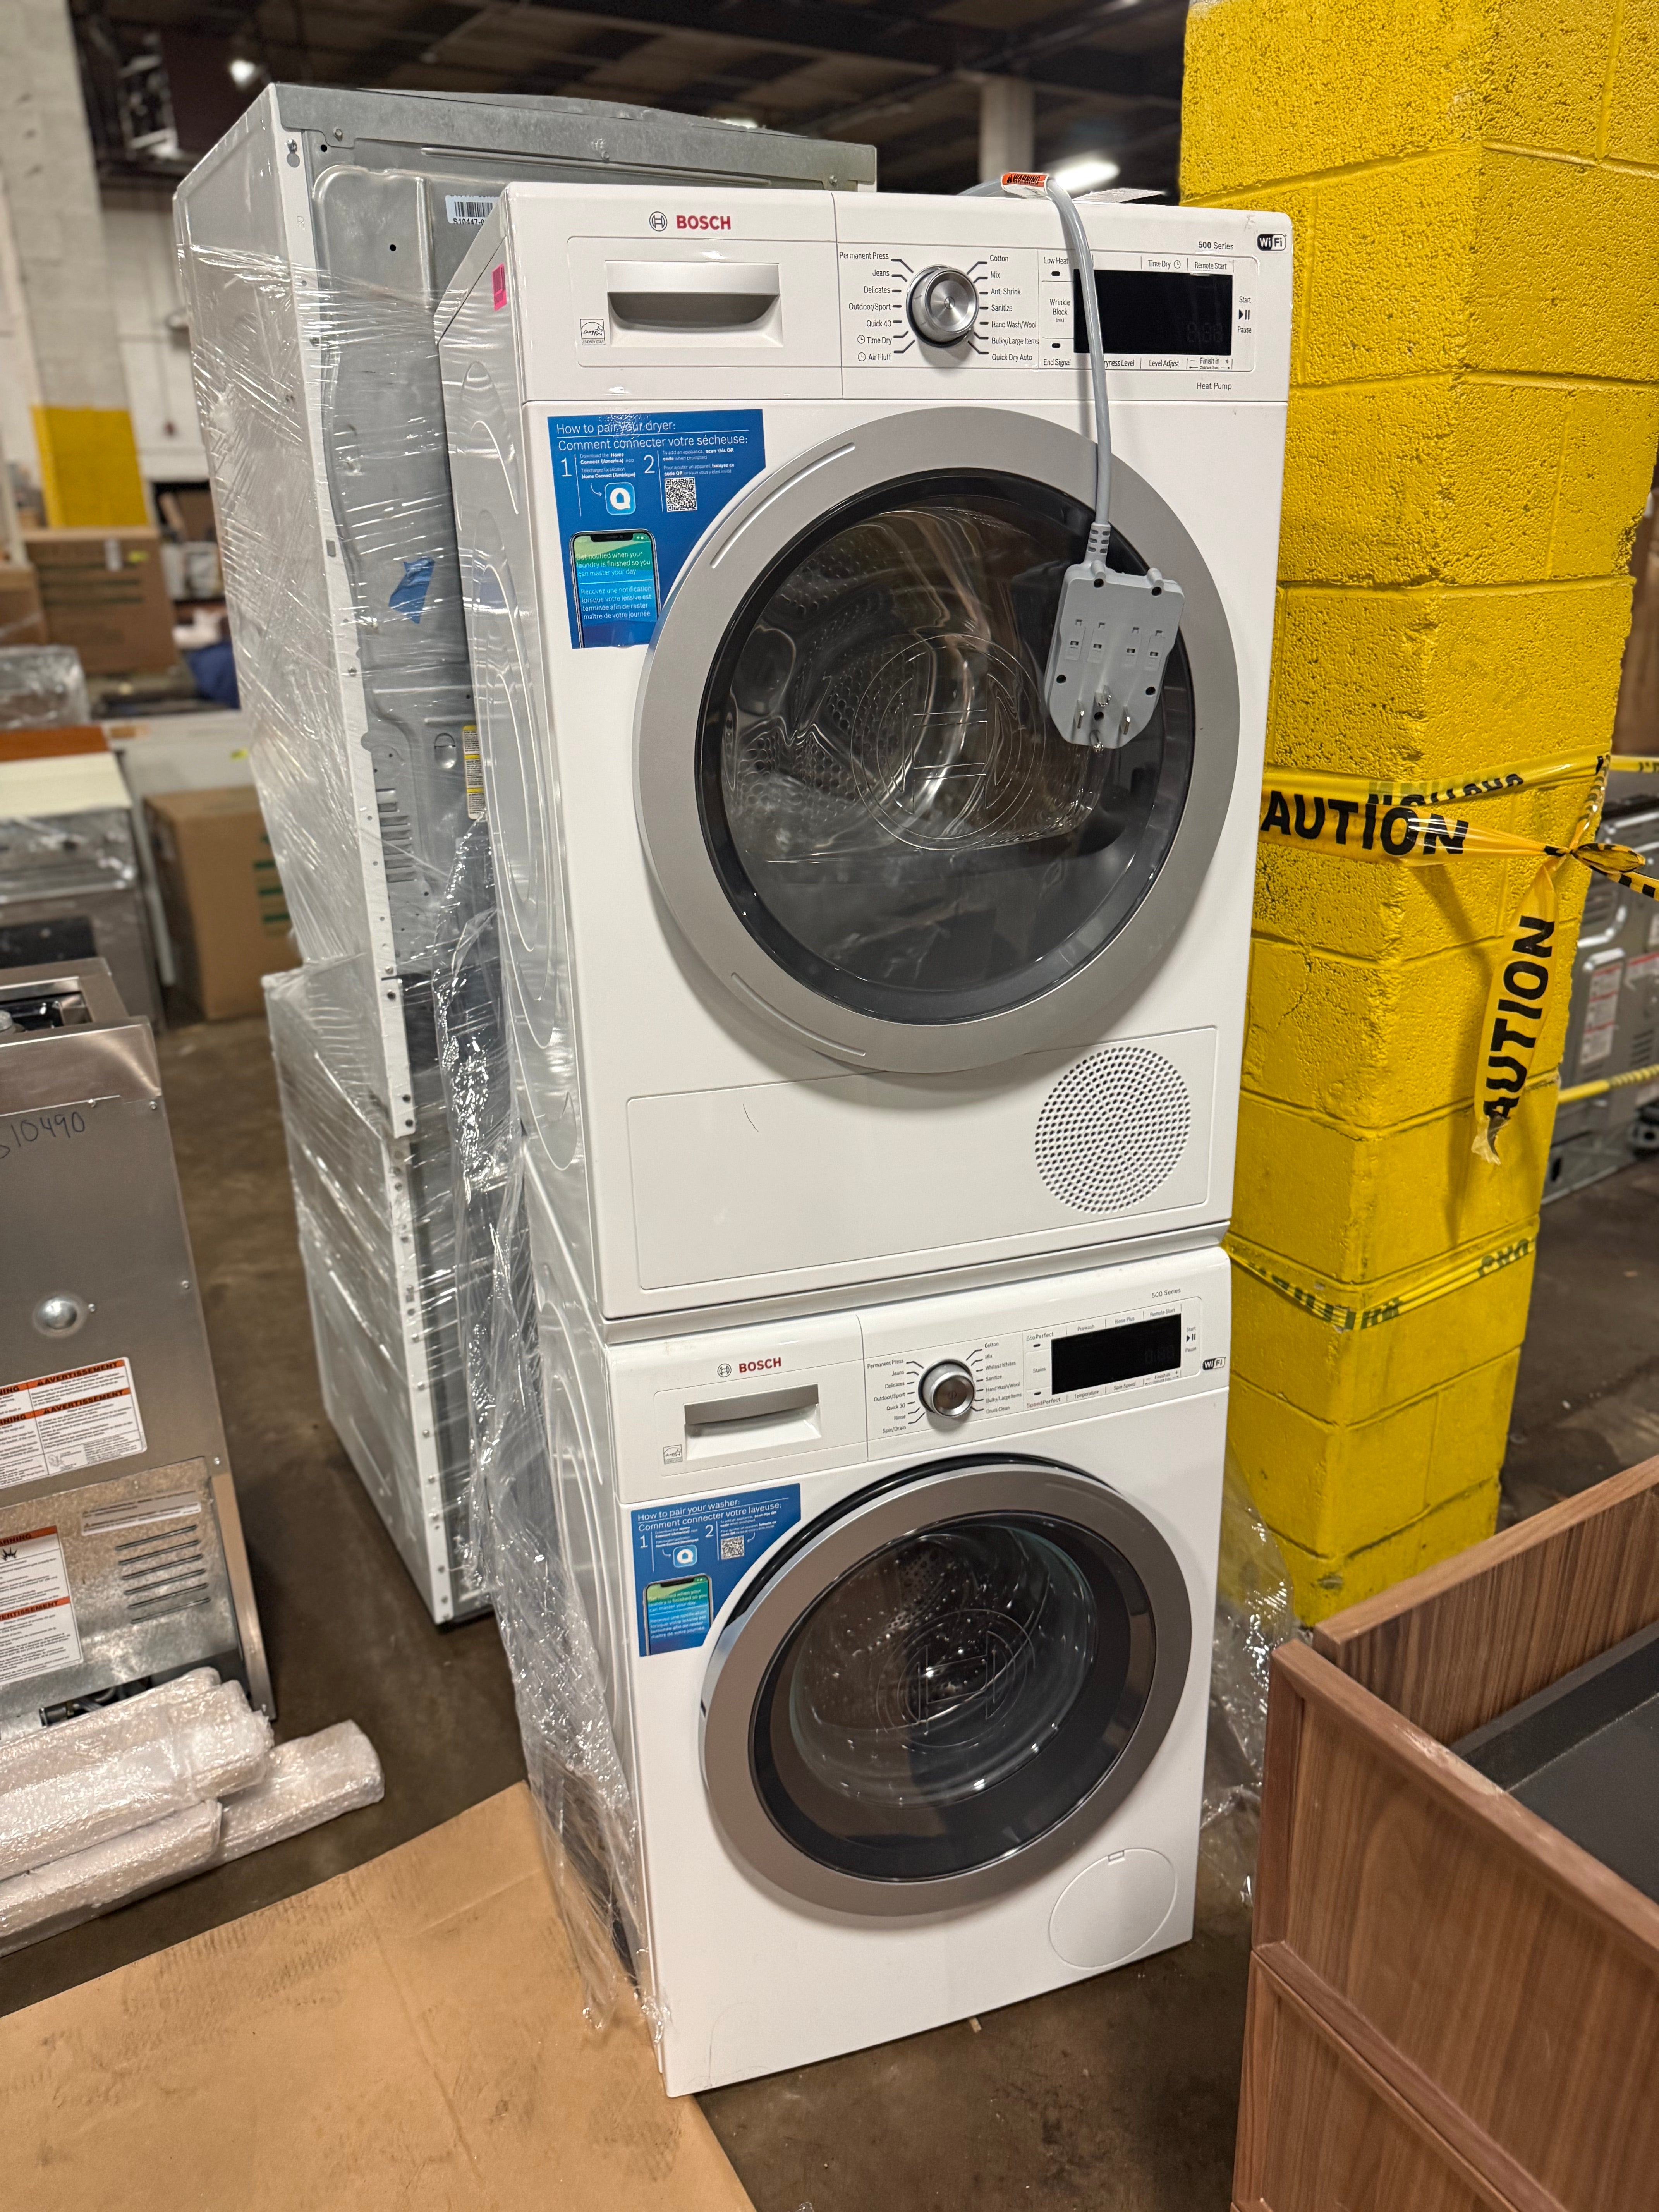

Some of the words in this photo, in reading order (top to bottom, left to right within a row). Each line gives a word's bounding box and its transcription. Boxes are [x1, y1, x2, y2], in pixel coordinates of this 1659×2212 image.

[676, 215, 731, 230] BOSCH
[1213, 242, 1233, 250] Series
[1259, 236, 1284, 249] WiFi
[1162, 260, 1171, 269] Dry
[849, 303, 891, 311] Outdoor/Sport
[1006, 321, 1036, 329] Wash/Wool
[881, 337, 892, 345] Dry
[992, 337, 1024, 346] Bulky/Large
[1008, 354, 1018, 362] Dry
[1055, 359, 1071, 367] Signal
[1163, 360, 1179, 368] Adjust
[1214, 382, 1232, 391] Pump
[557, 423, 580, 434] How
[584, 423, 594, 433] to
[598, 422, 616, 435] pair
[646, 420, 676, 433] dryer:
[559, 438, 611, 450] Comment
[614, 438, 665, 448] connecter
[668, 436, 694, 446] votre
[697, 434, 747, 445] sécheuse:
[561, 457, 572, 477] 1
[644, 455, 655, 474] 2
[1261, 790, 1469, 856] AUTION
[1482, 915, 1556, 1119] AUTION
[1026, 1332, 1054, 1341] EcoPerfect
[739, 1357, 781, 1374] BOSCH
[867, 1361, 891, 1369] Permanent
[45, 1362, 117, 1384] AVERTISSEMENT
[51, 1390, 124, 1413] AVERTISSEMENT
[1027, 1398, 1061, 1408] SpeedPerfect
[638, 1513, 657, 1522] How
[670, 1507, 686, 1518] pair
[688, 1505, 706, 1515] your
[708, 1499, 740, 1510] washer:
[639, 1520, 680, 1531] Comment
[682, 1513, 723, 1525] connecter
[726, 1508, 746, 1517] votre
[749, 1503, 781, 1514] laveuse:
[705, 1524, 714, 1538] 2
[640, 1535, 648, 1548] 1
